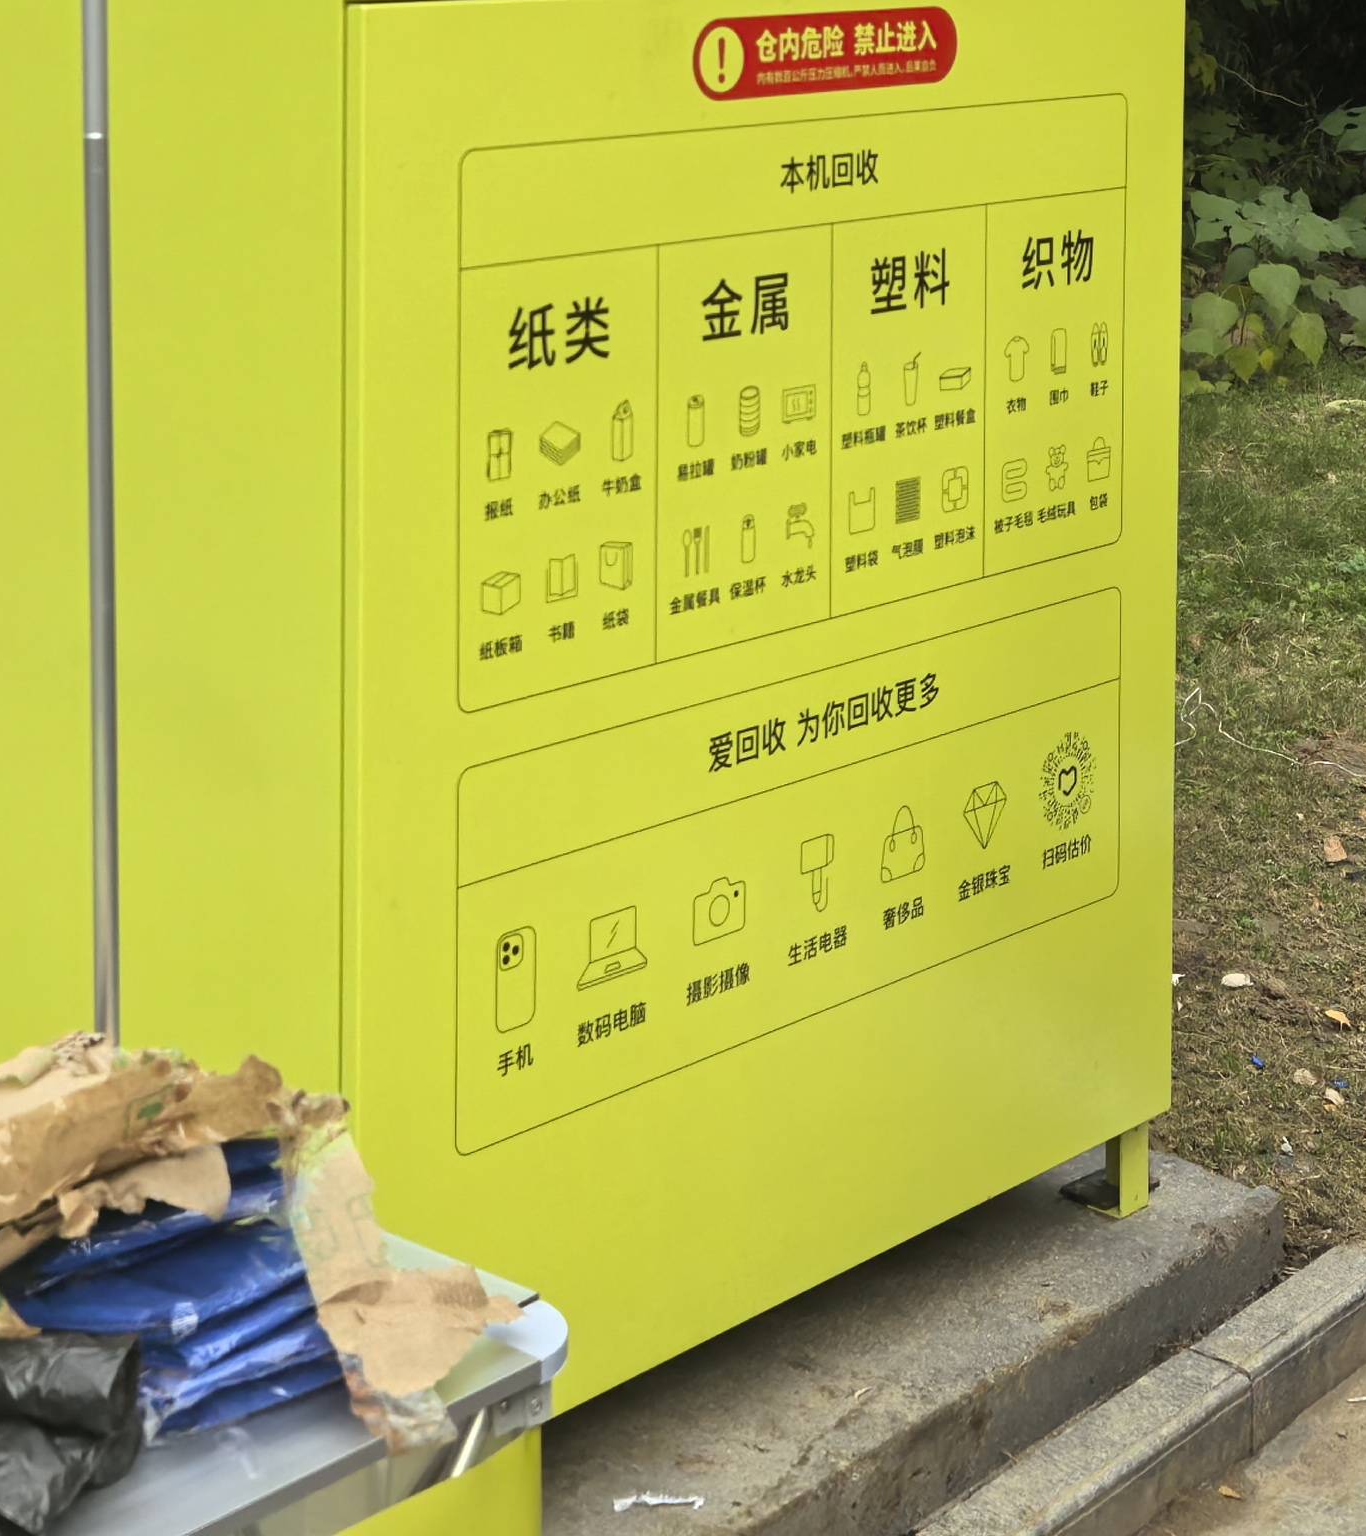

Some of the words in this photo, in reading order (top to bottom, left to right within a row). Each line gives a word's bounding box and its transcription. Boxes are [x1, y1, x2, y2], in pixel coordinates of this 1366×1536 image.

[755, 24, 845, 64] 仓内危险
[853, 20, 937, 56] 禁止进入
[780, 148, 879, 194] 本机回收
[1021, 229, 1094, 290] 织物
[870, 247, 950, 315] 塑料
[701, 272, 789, 342] 金属
[508, 296, 610, 371] 纸类
[1006, 396, 1027, 415] 衣物
[1090, 379, 1109, 397] 鞋子
[781, 439, 818, 462] 小家电
[538, 484, 581, 510] 办公纸
[602, 473, 642, 497] 牛奶盒
[1089, 492, 1108, 511] 包袋
[484, 497, 514, 522] 报纸
[729, 575, 767, 601] 保温杯
[781, 564, 817, 588] 水龙头
[602, 608, 630, 631] 纸袋
[479, 634, 523, 661] 纸板箱
[708, 717, 787, 773] 爱回收
[796, 671, 940, 748] 为你回收更多
[1042, 833, 1092, 870] 扫码估价
[958, 864, 1011, 902] 金银珠宝
[882, 895, 924, 931] 奢侈品
[787, 924, 848, 967] 生活电器
[686, 962, 750, 1007] 摄影摄像
[577, 1001, 647, 1048] 数码电脑
[496, 1043, 534, 1078] 手机
